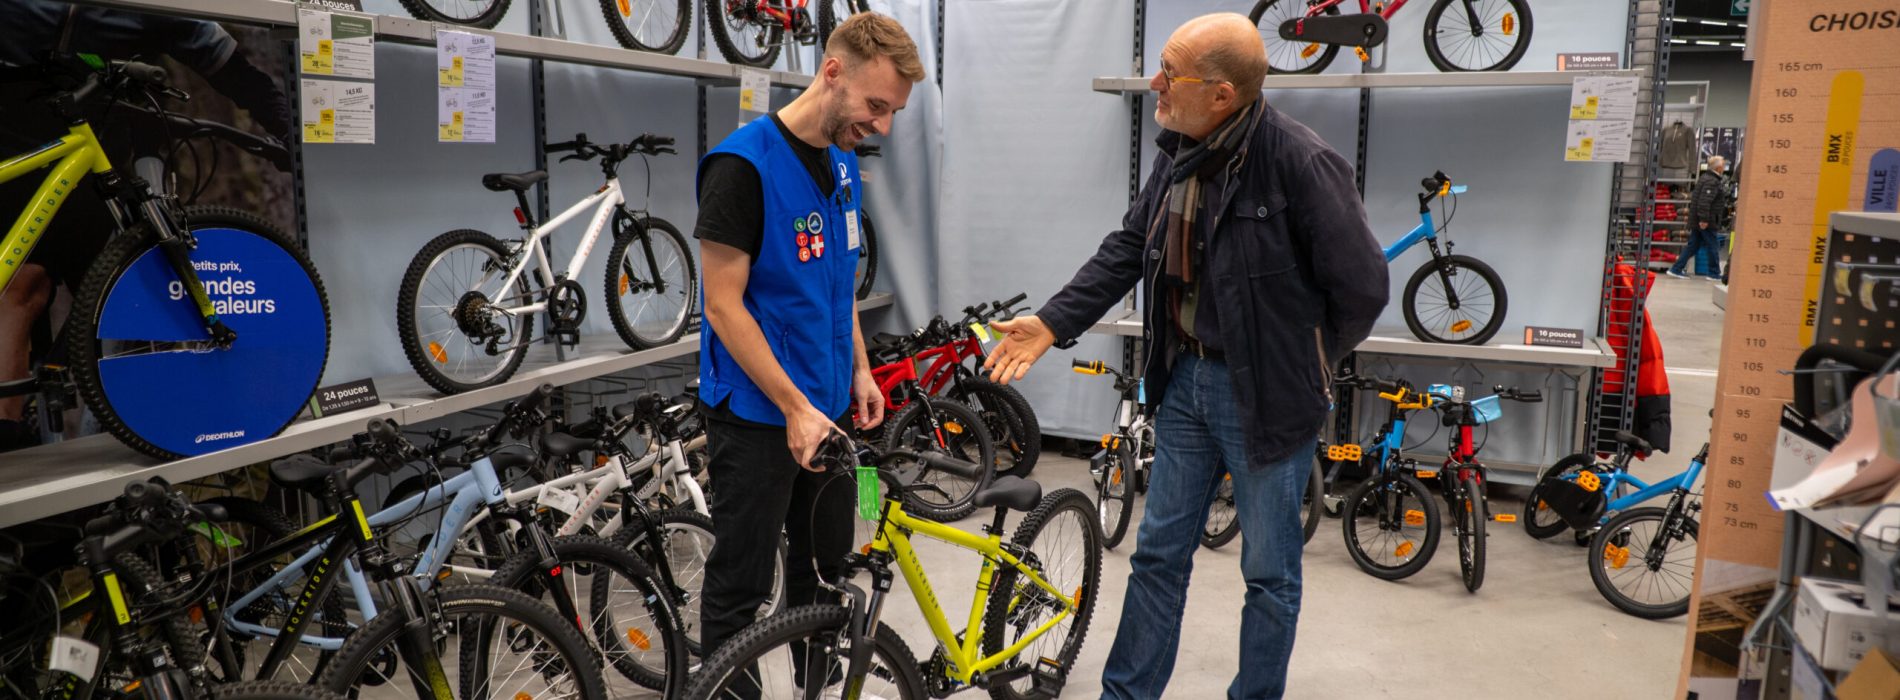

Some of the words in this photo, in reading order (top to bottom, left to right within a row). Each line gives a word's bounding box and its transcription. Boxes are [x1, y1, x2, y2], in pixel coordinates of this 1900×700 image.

[1582, 55, 1611, 64] pouces
[1779, 62, 1800, 72] 165
[1803, 63, 1823, 71] cm
[1776, 88, 1797, 97] 160
[1773, 113, 1794, 123] 155
[1769, 139, 1791, 149] 150
[1826, 134, 1842, 163] BMX
[1766, 165, 1788, 174] 145
[1870, 170, 1887, 205] VILLE
[1763, 190, 1785, 199] 140
[5, 179, 69, 266] ROCKRIDER
[1760, 215, 1782, 225] 135
[1757, 240, 1778, 249] 130
[220, 261, 242, 273] prix,
[1754, 264, 1775, 274] 125
[168, 276, 256, 300] gndes
[1751, 289, 1772, 299] 120
[1748, 313, 1769, 323] 115
[1745, 338, 1767, 348] 110
[1743, 362, 1764, 372] 105
[324, 391, 336, 401] 24
[337, 385, 368, 400] pouces
[1740, 386, 1760, 396] 100
[1736, 409, 1751, 419] 95
[205, 430, 245, 441] DECATHLON
[1733, 432, 1748, 442] 90
[1730, 456, 1744, 466] 85
[1727, 480, 1742, 489] 80
[1725, 502, 1739, 512] 75
[1723, 517, 1737, 527] 73
[1740, 521, 1758, 529] cm
[287, 557, 331, 633] ROCKRIDER
